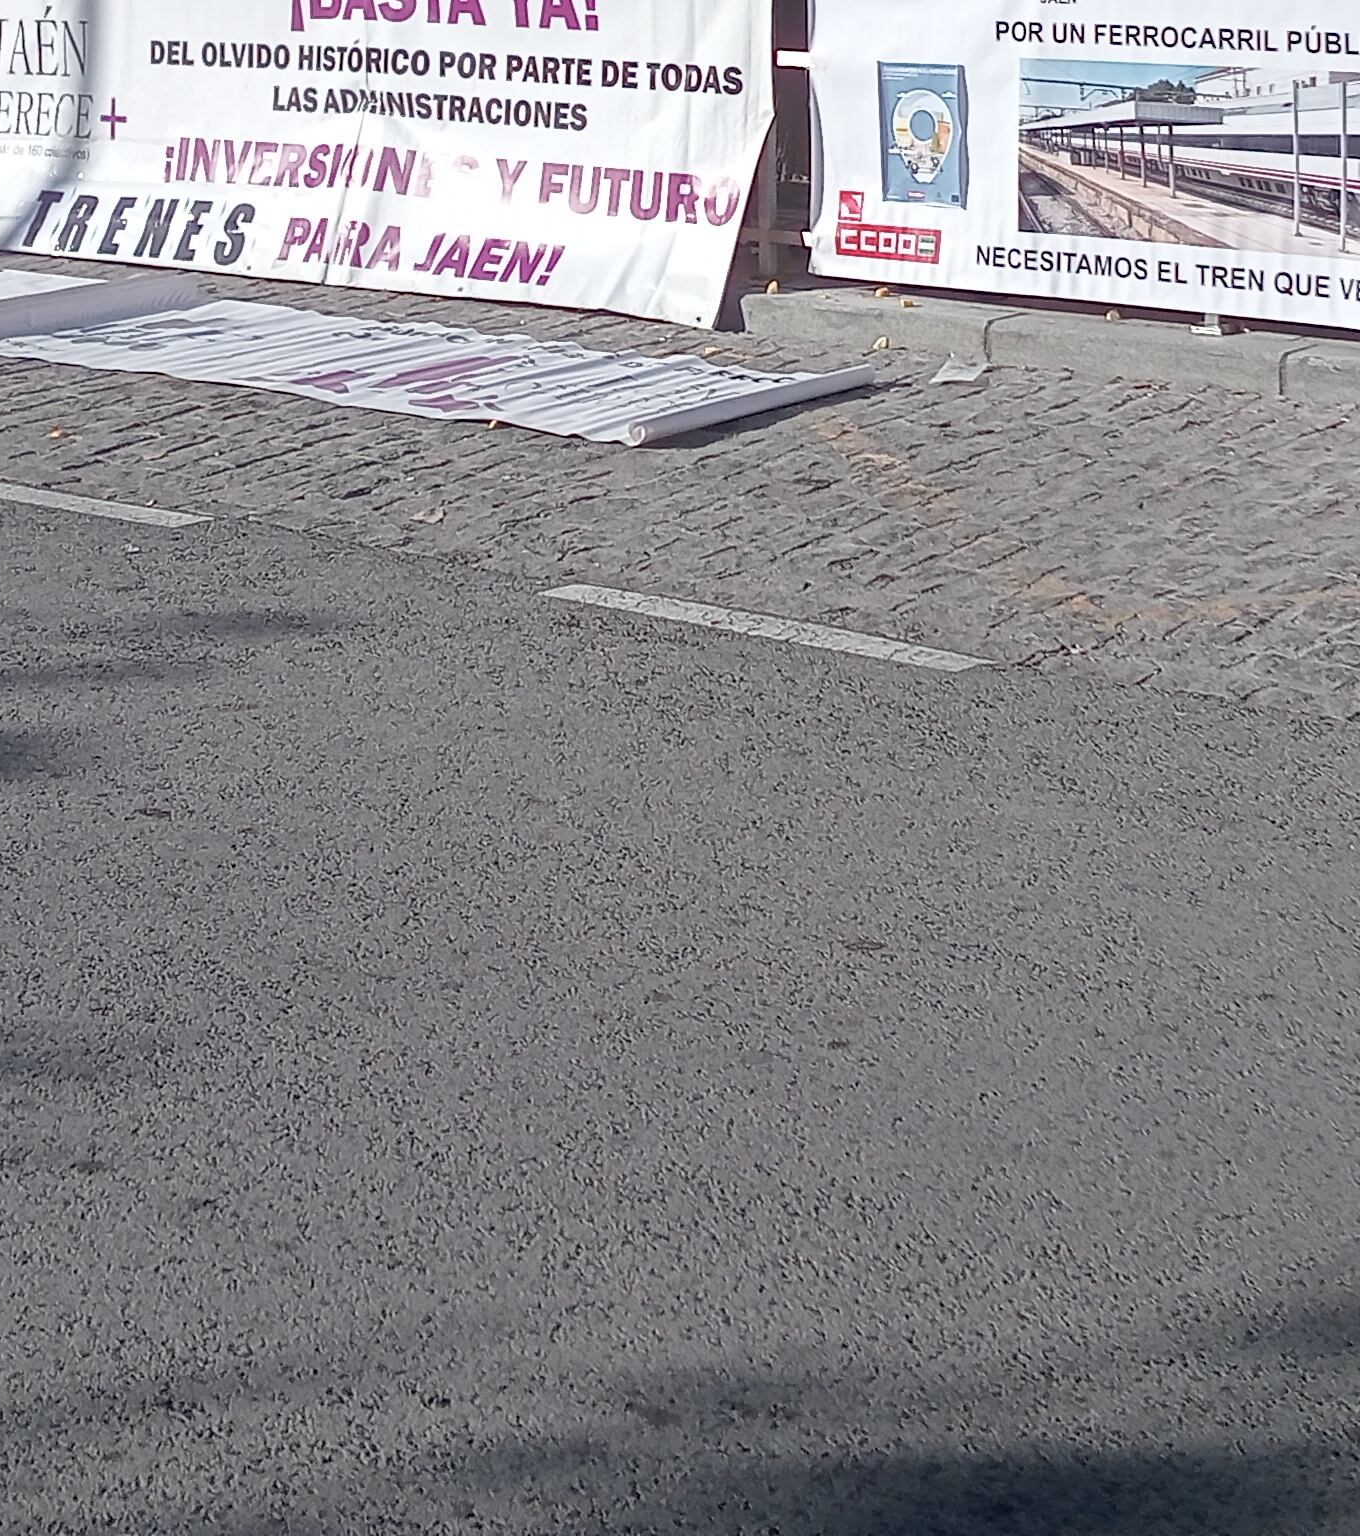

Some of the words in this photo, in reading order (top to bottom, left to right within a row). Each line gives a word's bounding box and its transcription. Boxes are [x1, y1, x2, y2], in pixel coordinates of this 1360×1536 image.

[995, 20, 1043, 43] POR
[1052, 22, 1085, 44] UN
[1095, 23, 1277, 53] FERROCARRIL
[150, 40, 194, 66] DEL
[201, 42, 290, 69] OLVIDO
[298, 39, 430, 76] HISTÓRICO
[439, 50, 497, 80] POR
[505, 54, 592, 86] PARTE
[601, 60, 639, 89] DE
[646, 62, 743, 95] TODAS
[272, 86, 318, 113] LAS
[324, 89, 588, 131] ADMINISTRACIONES
[496, 158, 528, 206] Y
[538, 162, 741, 227] FUTURO
[21, 189, 256, 266] TRENES
[277, 217, 401, 272] PARA
[413, 232, 566, 287] JAEN!
[840, 228, 918, 257] CCOO
[976, 244, 1148, 280] NECESITAMOS
[1157, 260, 1188, 284] EL
[1195, 264, 1265, 291] TREN
[1274, 271, 1330, 298] QUE
